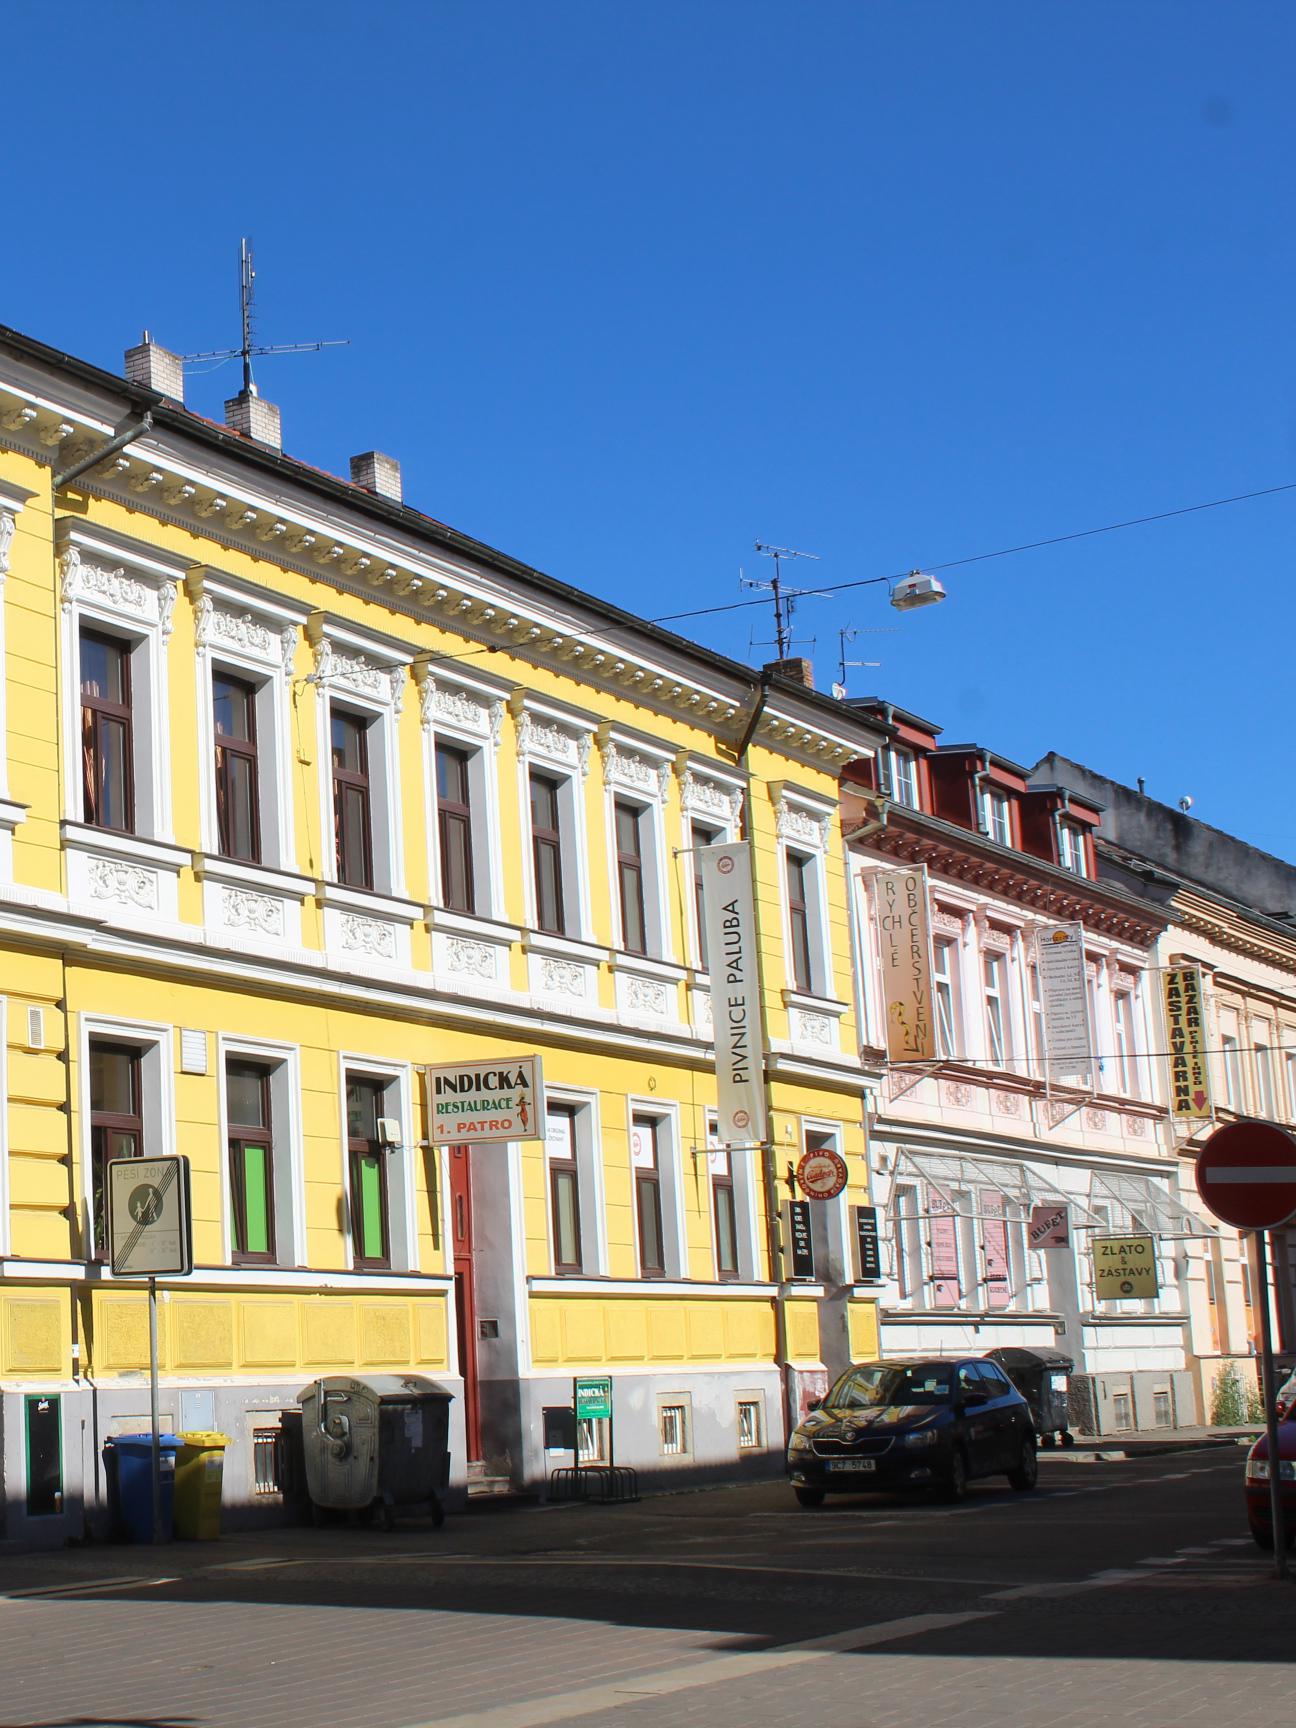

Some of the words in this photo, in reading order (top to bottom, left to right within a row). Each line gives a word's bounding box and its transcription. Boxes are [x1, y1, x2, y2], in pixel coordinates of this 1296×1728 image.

[722, 899, 744, 983] PALUBA
[1181, 971, 1199, 1028] BAZAR
[727, 996, 750, 1084] PIVNICE
[1166, 973, 1191, 1111] ZASTAVARNA
[435, 1065, 529, 1095] INDICKÁ
[436, 1097, 513, 1115] RESTAURACE
[457, 1119, 513, 1133] PATRO
[144, 1166, 168, 1178] ZON
[1101, 1244, 1145, 1255] ZLATO
